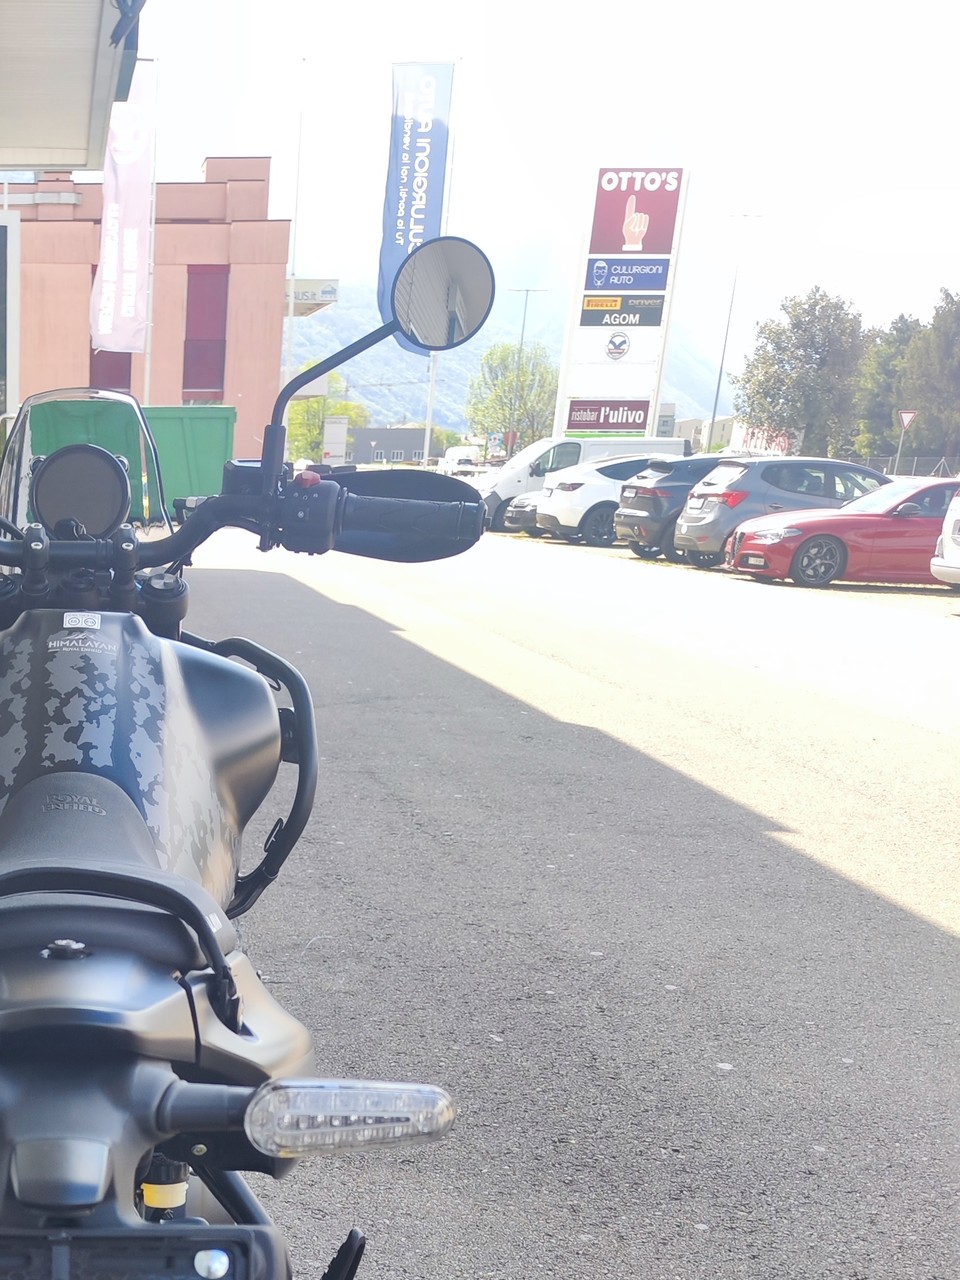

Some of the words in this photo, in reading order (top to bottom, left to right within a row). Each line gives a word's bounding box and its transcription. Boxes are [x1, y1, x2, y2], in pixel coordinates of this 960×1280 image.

[601, 171, 679, 192] OTTO'S
[611, 265, 663, 274] CULURGIONI
[609, 276, 633, 284] AUTO
[585, 299, 618, 308] PIRELLI
[602, 313, 640, 325] AGOM
[571, 408, 598, 421] ristobar
[599, 406, 644, 423] l'ulivo
[48, 640, 116, 653] HIMALAYAN
